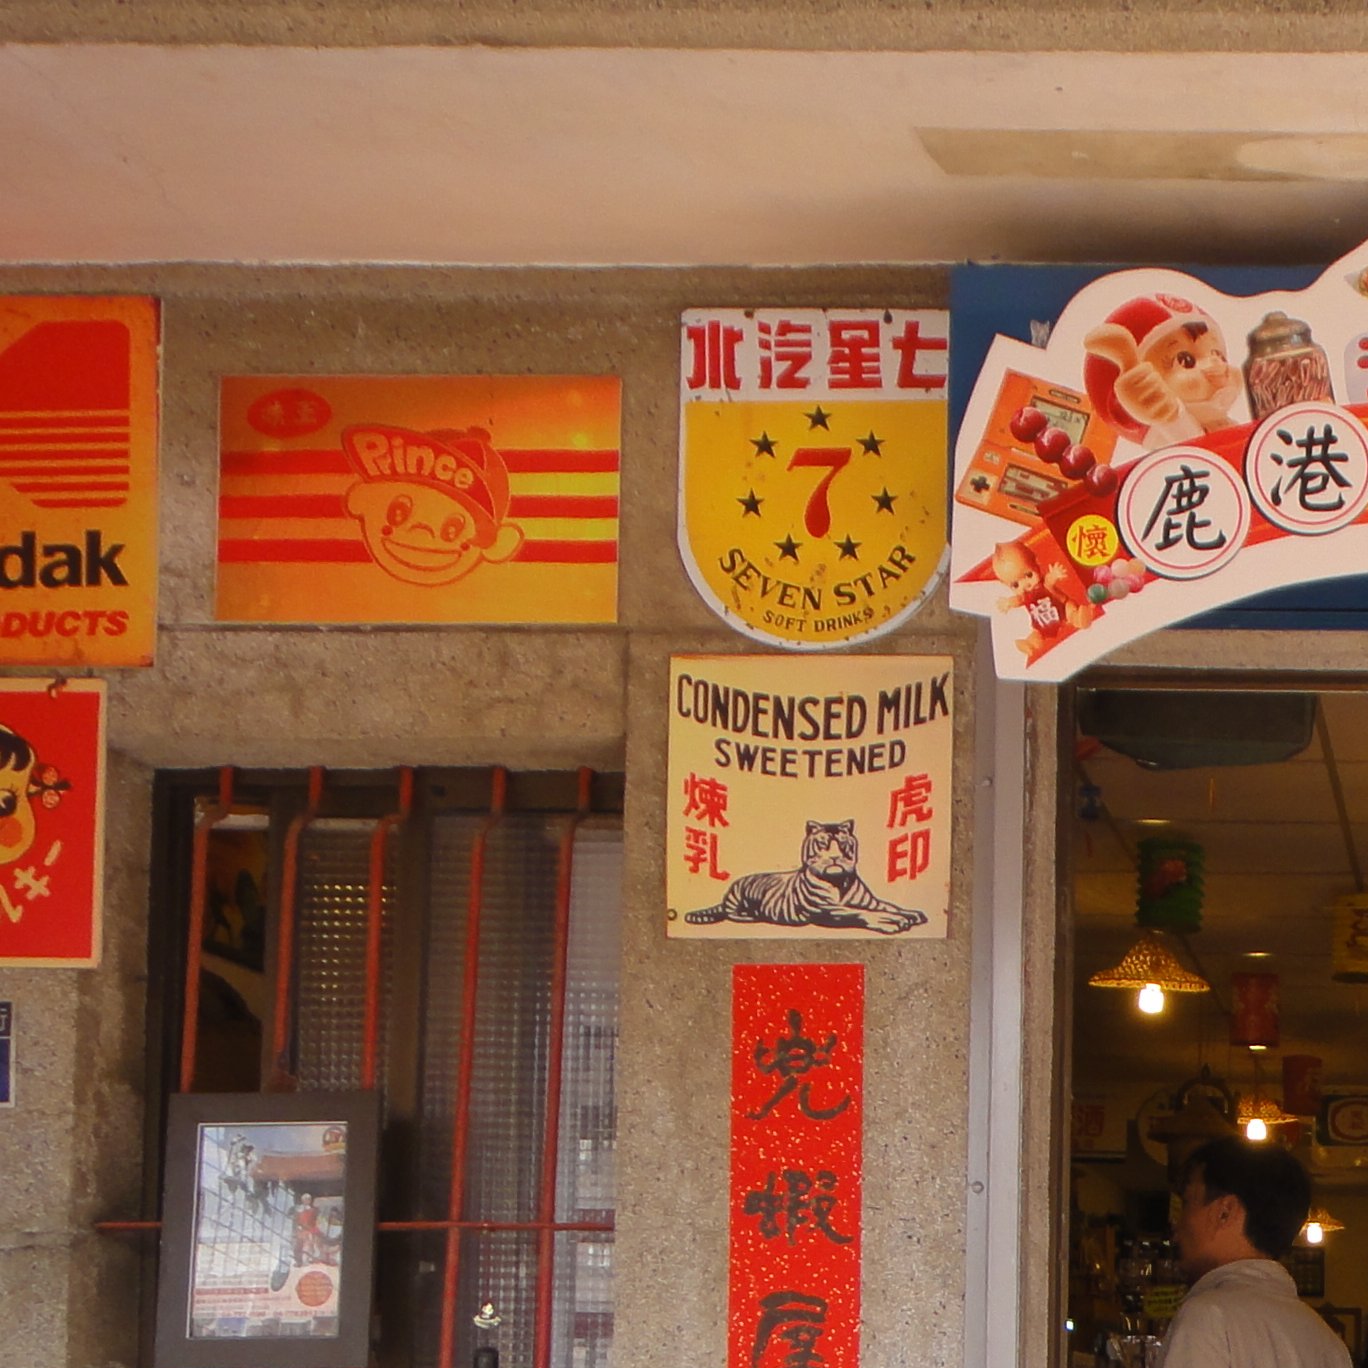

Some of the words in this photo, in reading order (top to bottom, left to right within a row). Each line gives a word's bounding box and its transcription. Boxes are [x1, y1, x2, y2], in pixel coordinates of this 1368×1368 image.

[352, 432, 475, 489] Prince
[786, 446, 852, 539] 7
[1072, 524, 1108, 560] 懷
[717, 547, 822, 611] SEVEN
[833, 543, 917, 608] STAR
[763, 608, 805, 633] SOFT
[813, 607, 875, 634] DRINKS
[676, 672, 867, 741] CONDENSED
[877, 670, 950, 736] MILK
[714, 737, 907, 778] SWEETENED
[683, 772, 730, 882] 煉乳
[886, 773, 934, 883] 虎印
